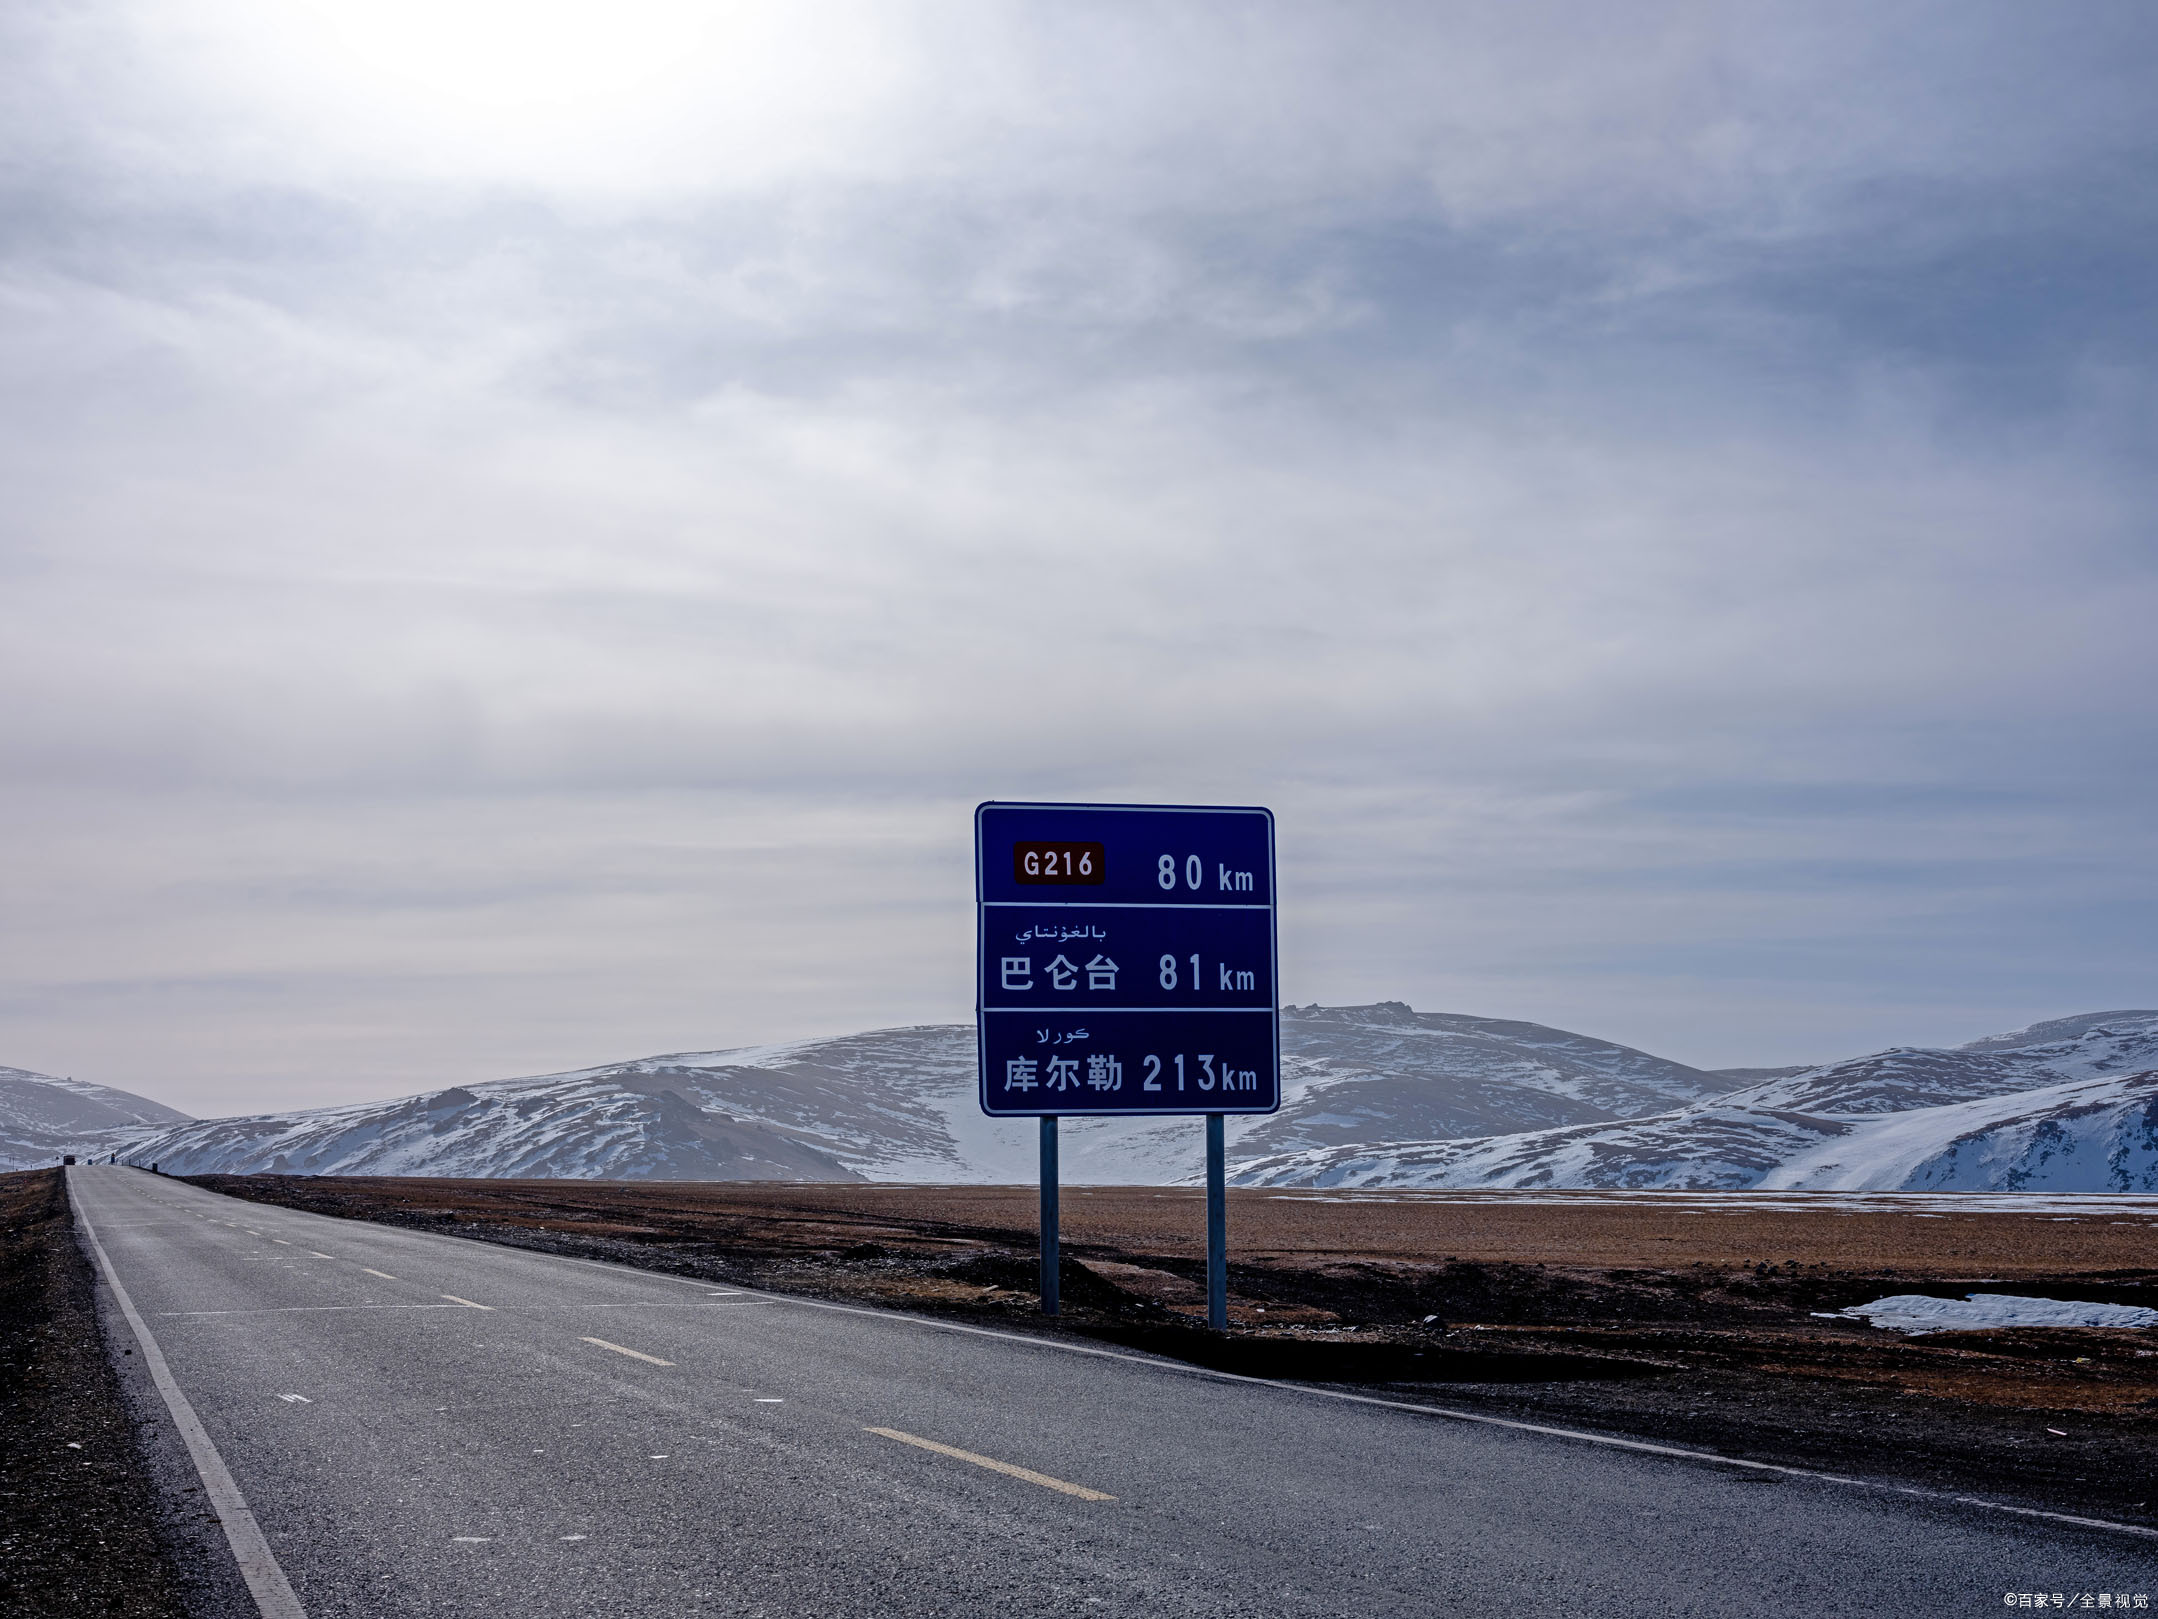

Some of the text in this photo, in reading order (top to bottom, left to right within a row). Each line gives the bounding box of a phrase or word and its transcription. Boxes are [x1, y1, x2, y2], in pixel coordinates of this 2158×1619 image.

[1024, 851, 1254, 891] G216 80 km
[1001, 953, 1255, 991] 巴仑台 81 km
[1004, 1054, 1257, 1092] 库尔勒 213 km
